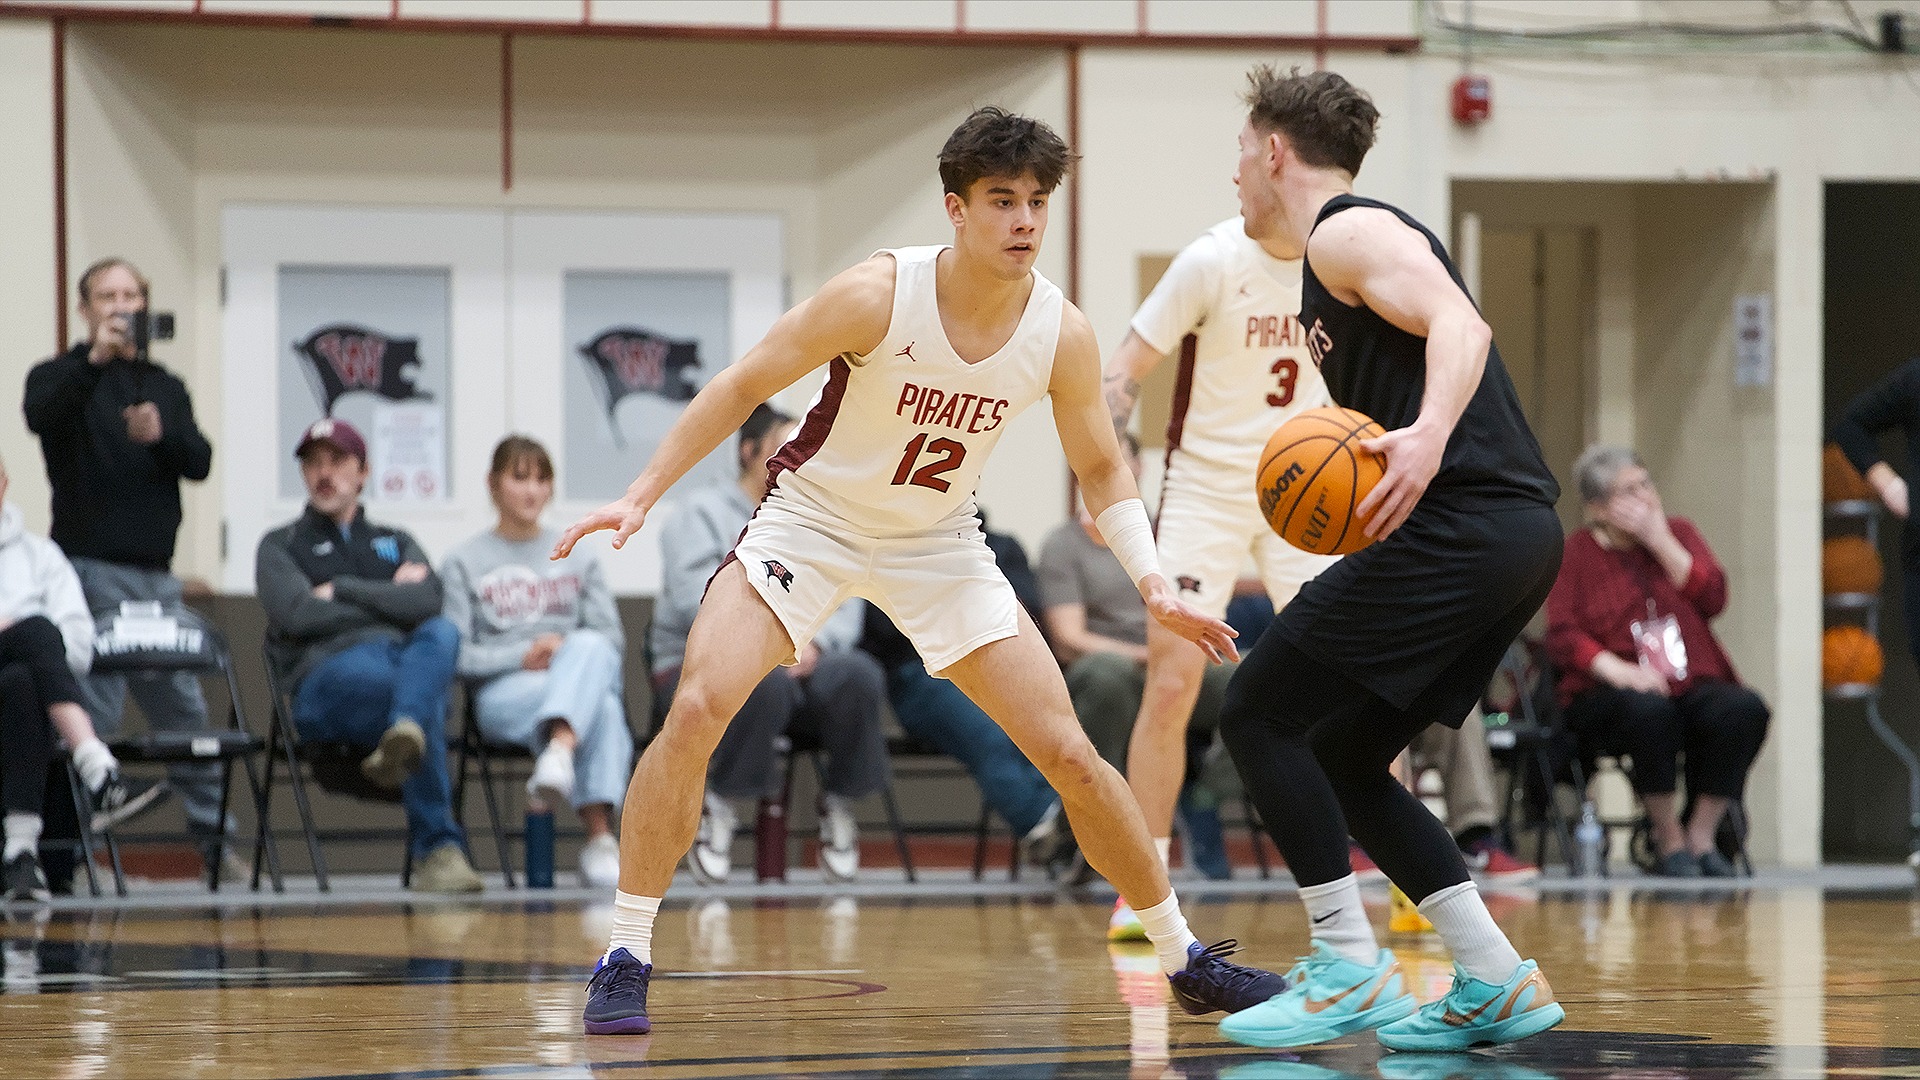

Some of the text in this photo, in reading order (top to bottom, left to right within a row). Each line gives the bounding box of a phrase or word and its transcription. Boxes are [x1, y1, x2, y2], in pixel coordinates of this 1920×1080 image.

[1245, 314, 1299, 348] PIRAT
[1266, 357, 1299, 407] 3
[895, 382, 1009, 434] PIRATES
[890, 432, 967, 494] 12
